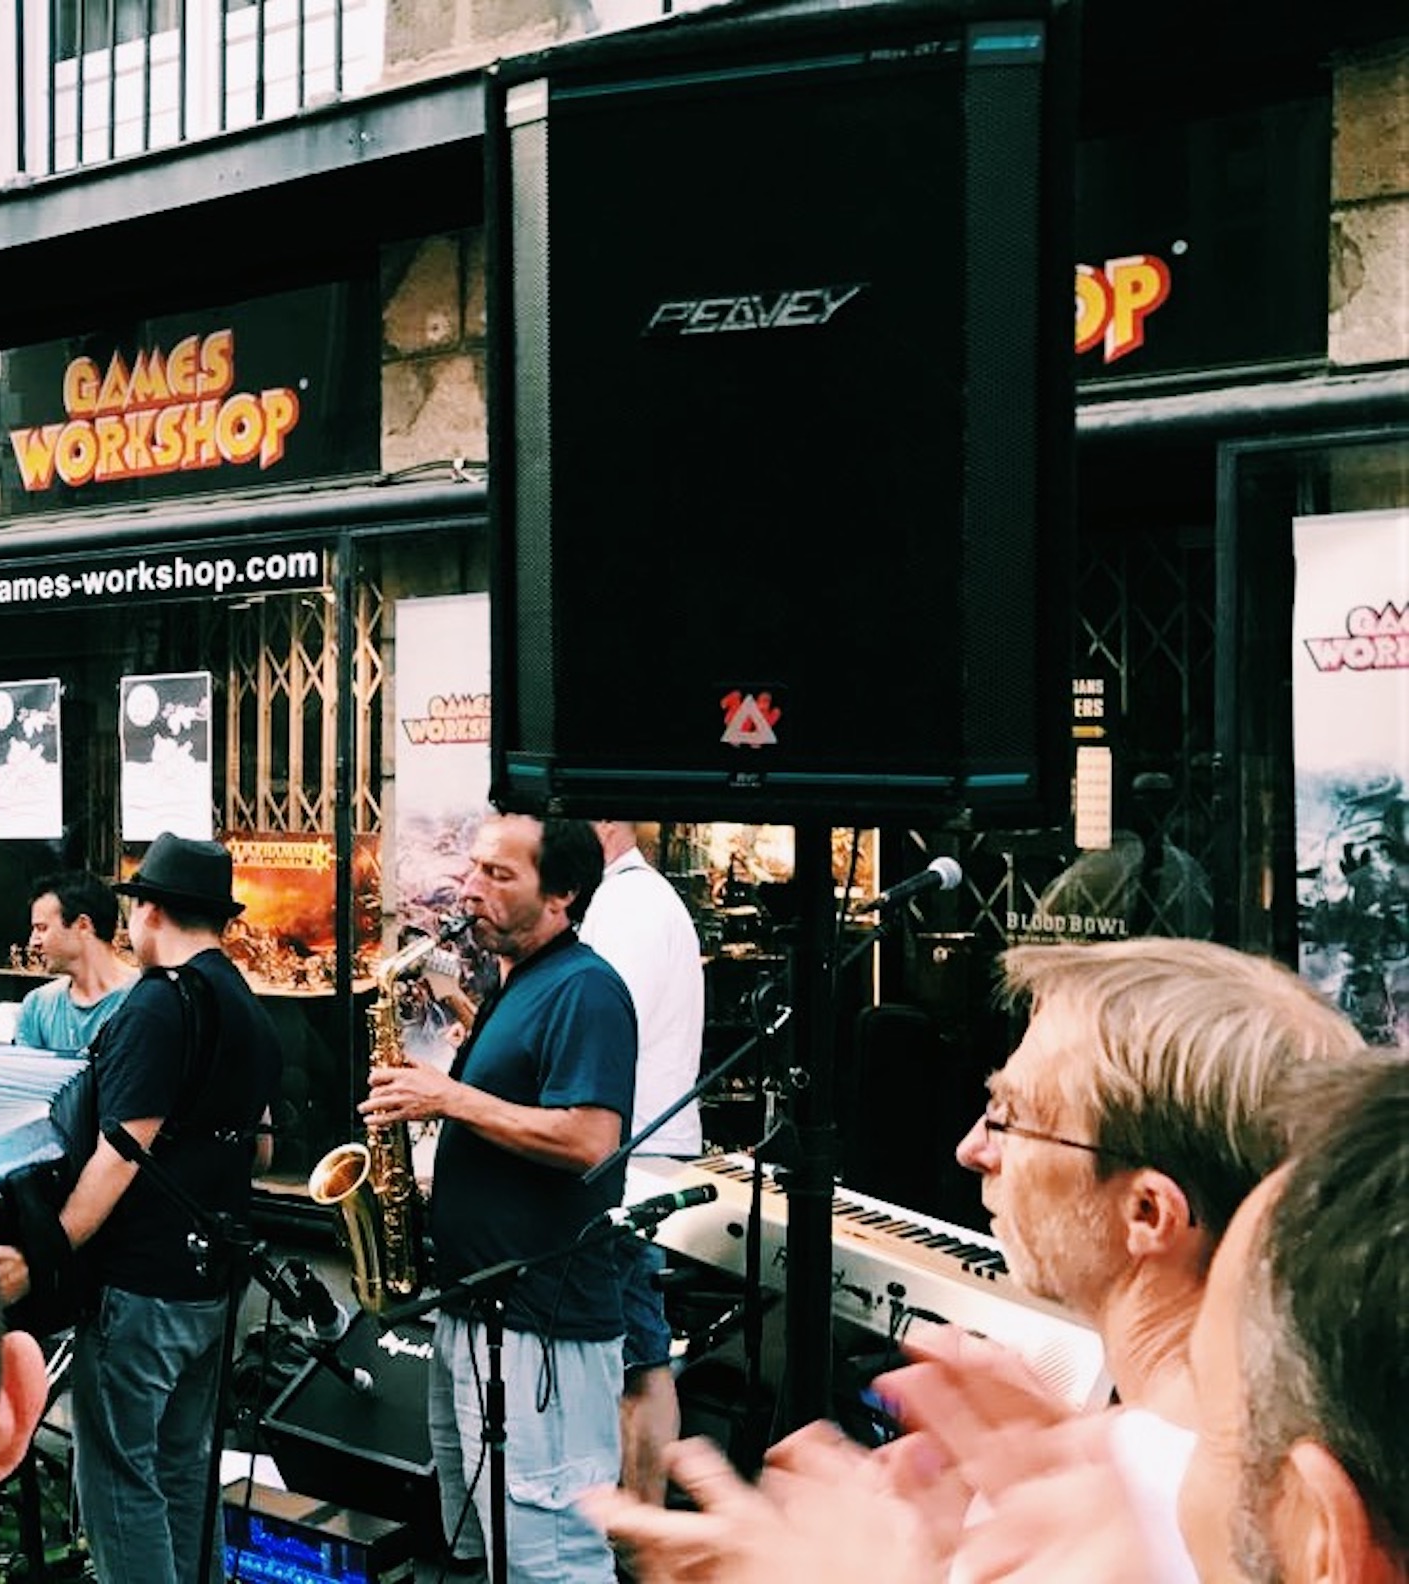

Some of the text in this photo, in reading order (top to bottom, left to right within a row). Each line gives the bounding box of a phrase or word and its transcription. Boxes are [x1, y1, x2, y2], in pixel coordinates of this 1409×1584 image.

[642, 283, 872, 335] PEAVEY
[64, 329, 235, 417] GAMES
[10, 386, 300, 491] WORKSHOP
[1006, 911, 1130, 936] BLOOD BOWL
